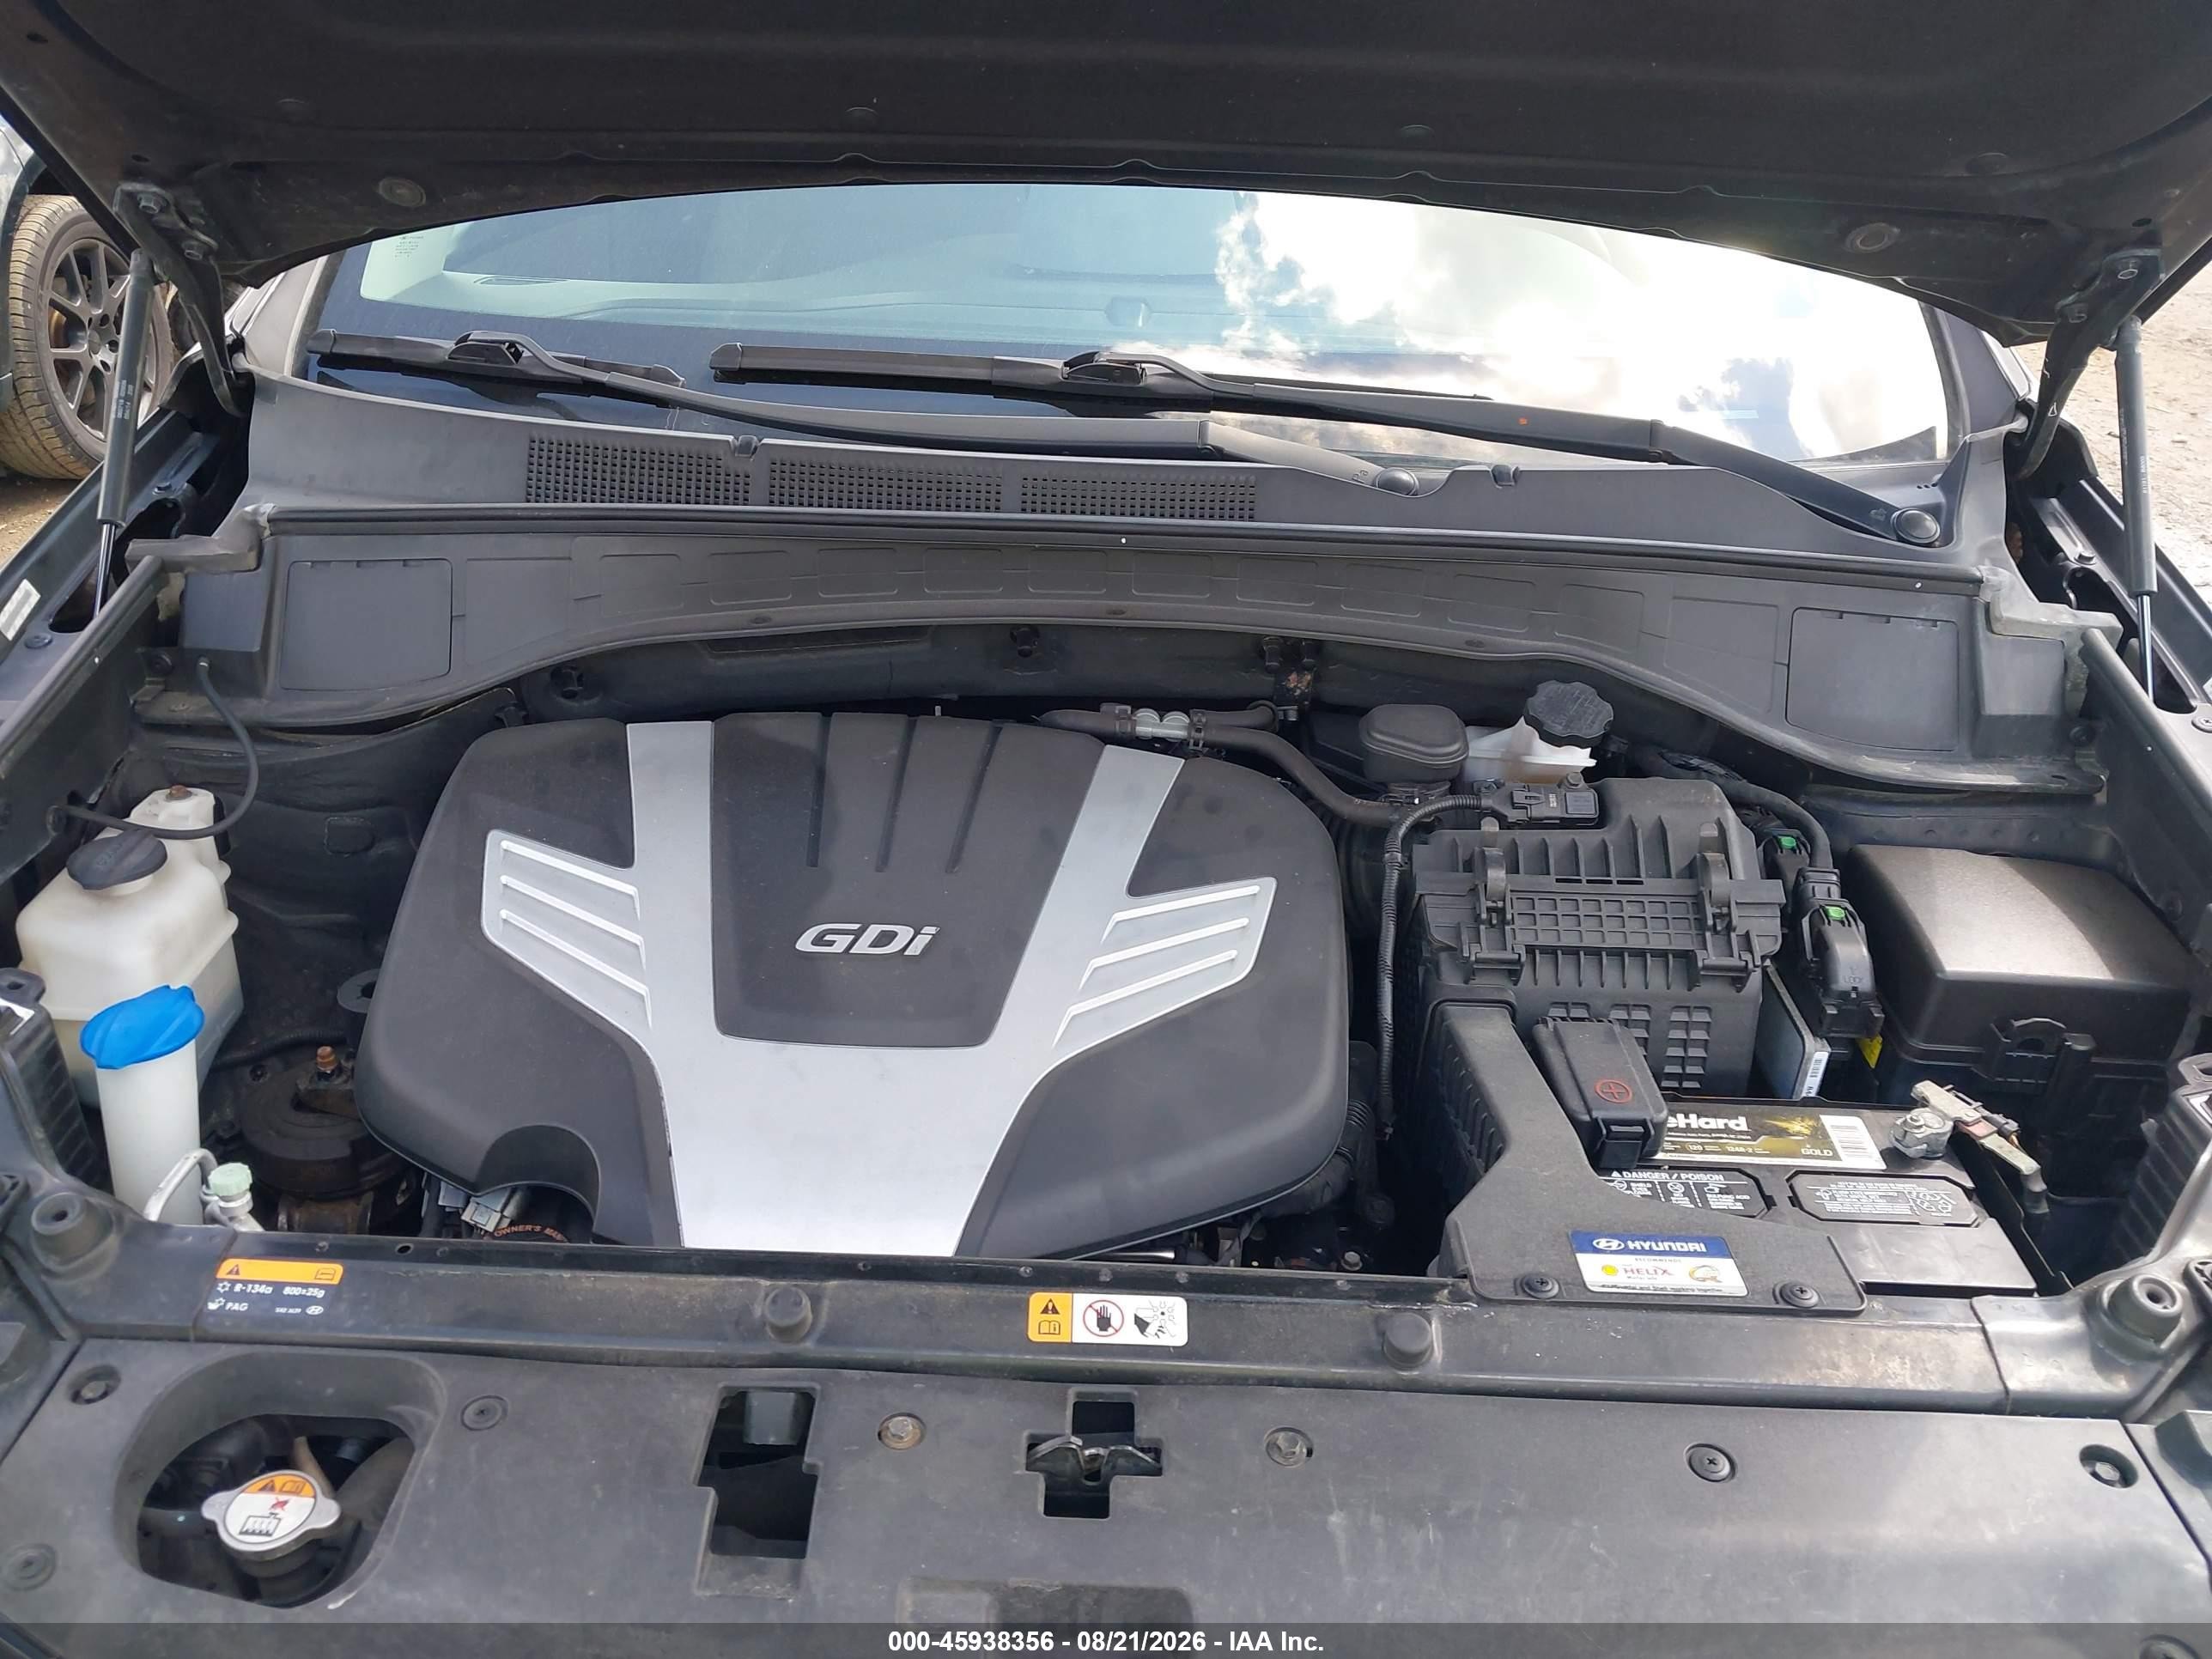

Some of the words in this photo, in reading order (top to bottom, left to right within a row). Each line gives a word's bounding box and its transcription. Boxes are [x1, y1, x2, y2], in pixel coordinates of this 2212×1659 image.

[794, 922, 941, 956] GDi
[1801, 1148, 1833, 1158] GOLD
[1622, 1170, 1670, 1180] DANGER
[1680, 1173, 1724, 1182] POISON
[494, 1224, 543, 1237] OWNER'S
[1626, 1240, 1707, 1253] HYUNDAI
[1622, 1266, 1675, 1276] HELIX
[233, 1283, 274, 1294] R-134a
[225, 1302, 249, 1311] PAG
